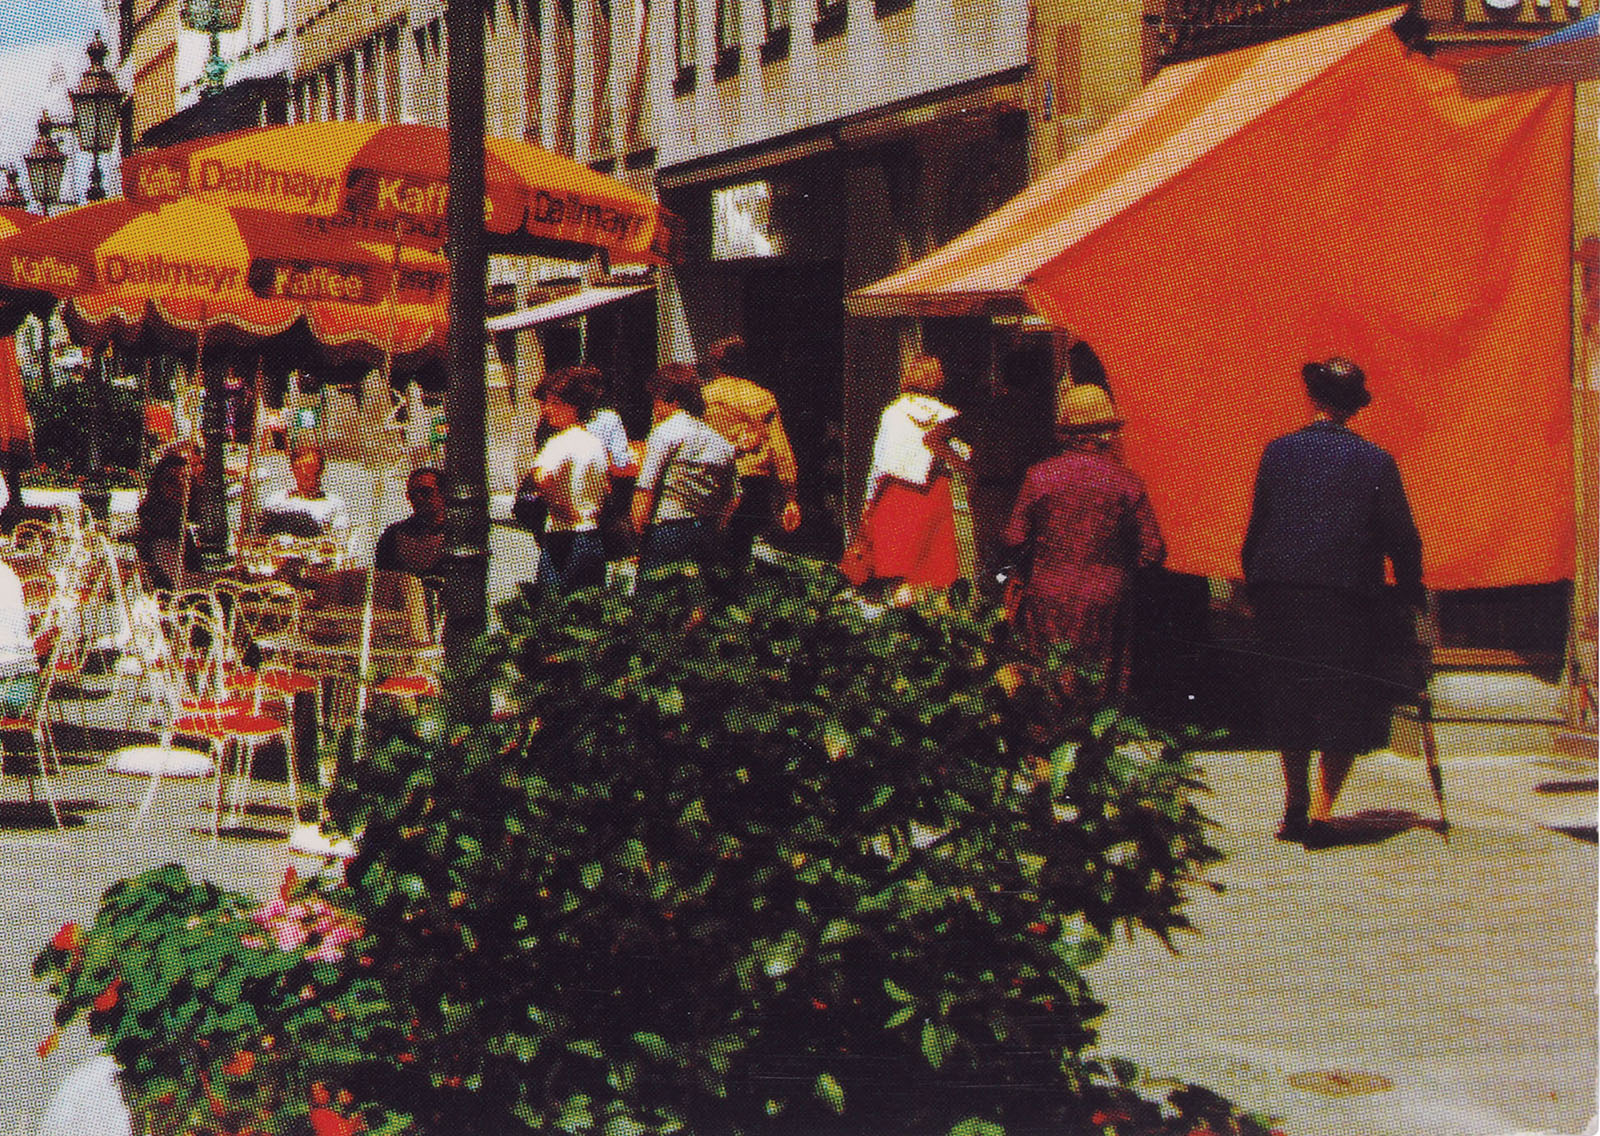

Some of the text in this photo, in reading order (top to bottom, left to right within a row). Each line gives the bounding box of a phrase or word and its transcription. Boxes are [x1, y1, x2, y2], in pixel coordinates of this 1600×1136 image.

[201, 160, 337, 207] Dallmayr
[534, 191, 646, 240] Dallmayr
[11, 255, 80, 288] Kaffee
[104, 255, 239, 295] Dallmayr
[273, 266, 363, 298] Kaffee
